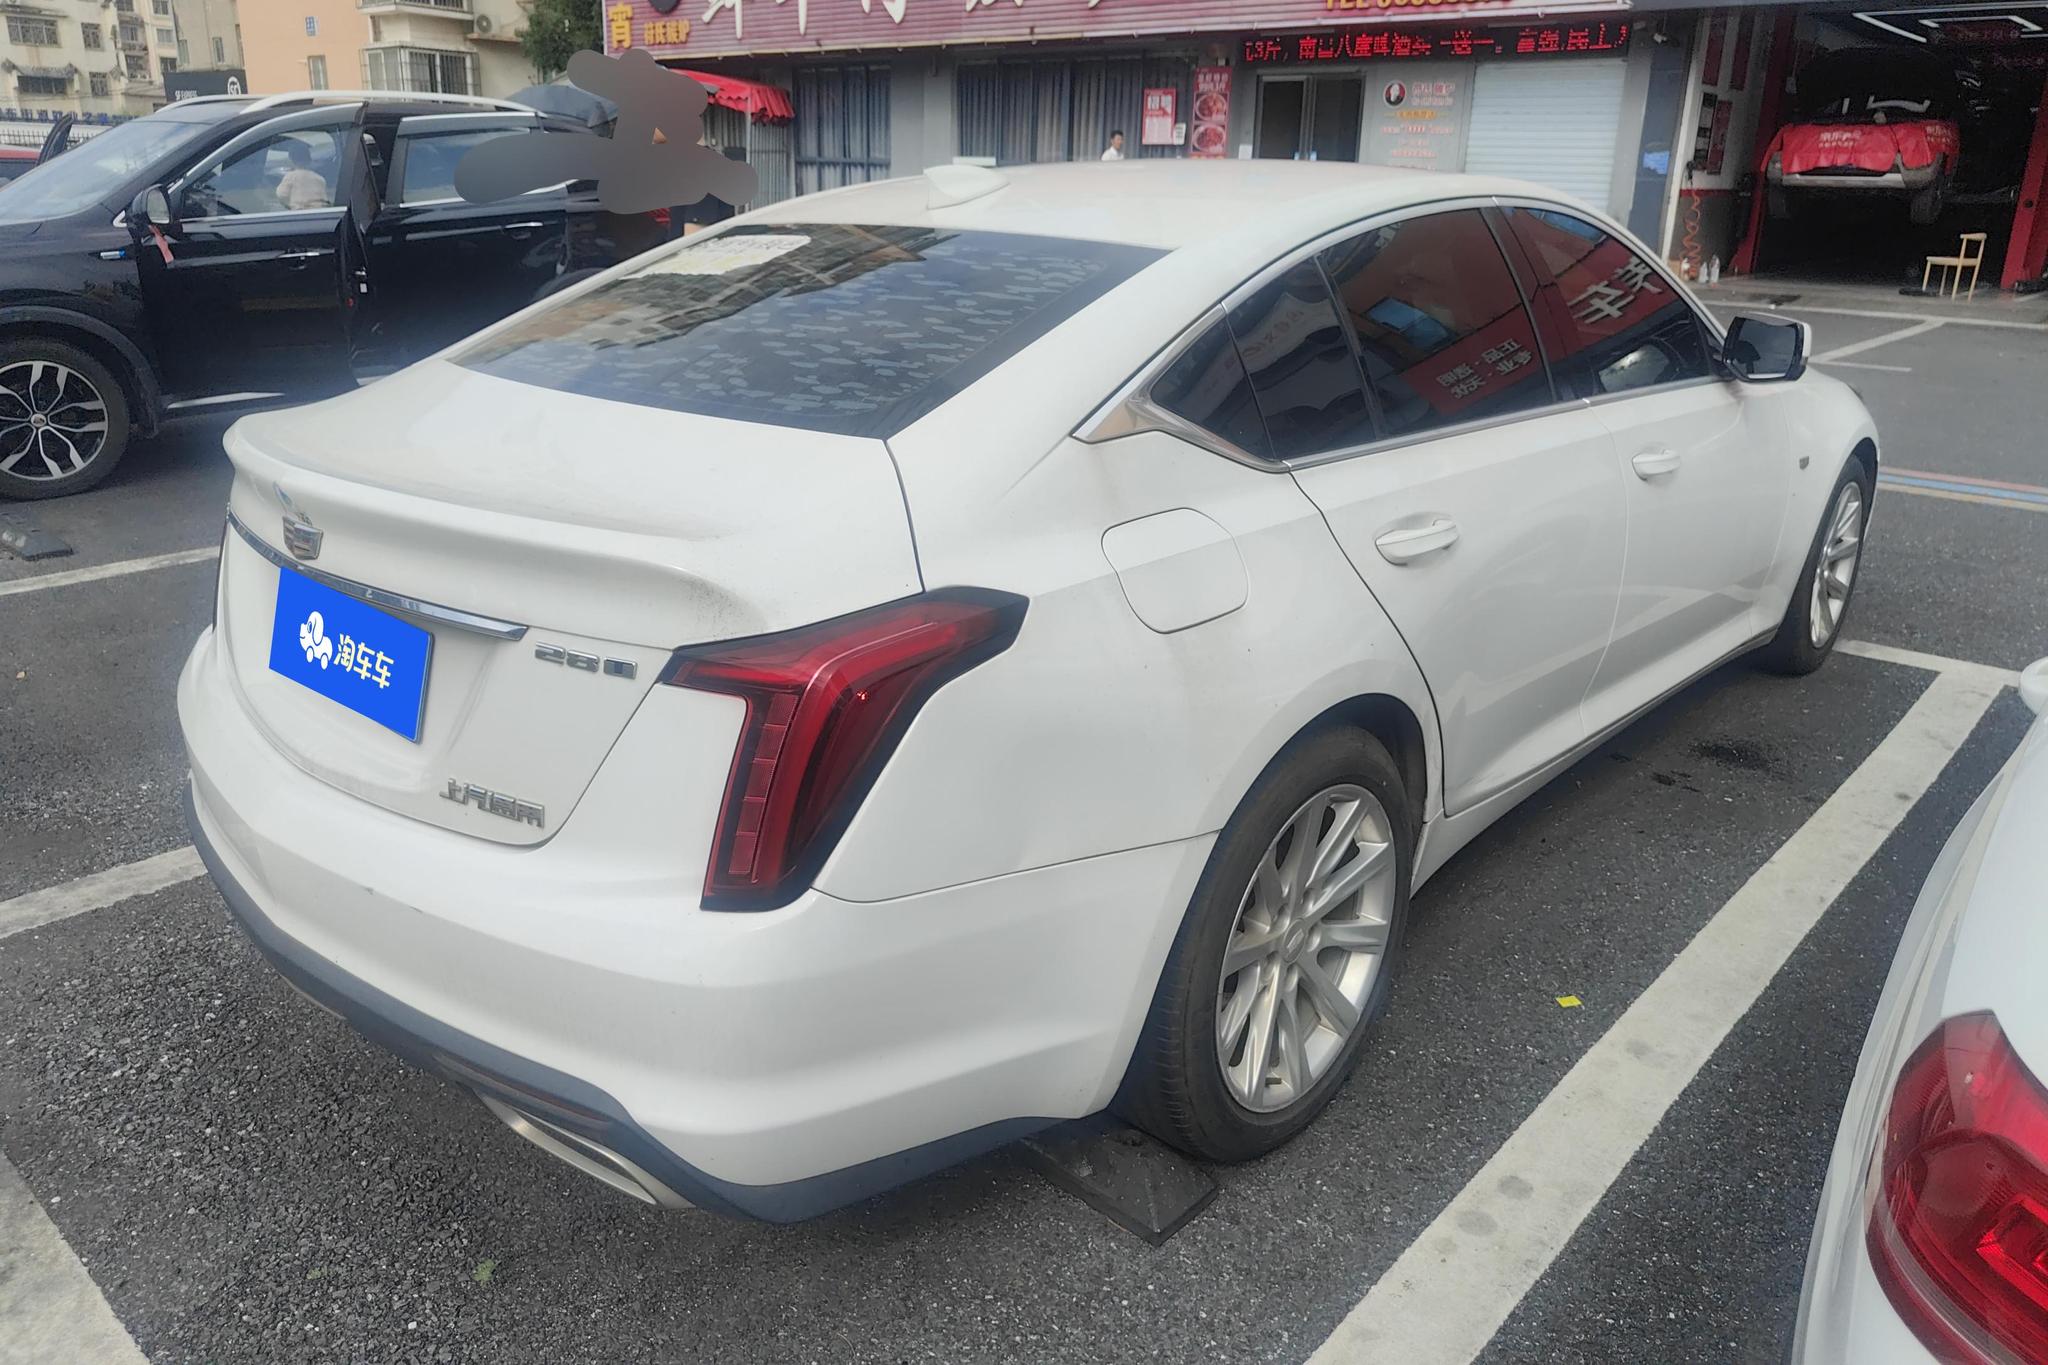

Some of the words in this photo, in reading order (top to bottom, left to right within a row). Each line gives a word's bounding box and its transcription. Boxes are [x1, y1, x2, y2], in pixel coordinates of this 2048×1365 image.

[608, 2, 632, 49] 宵
[438, 777, 545, 830] 上汽通用
